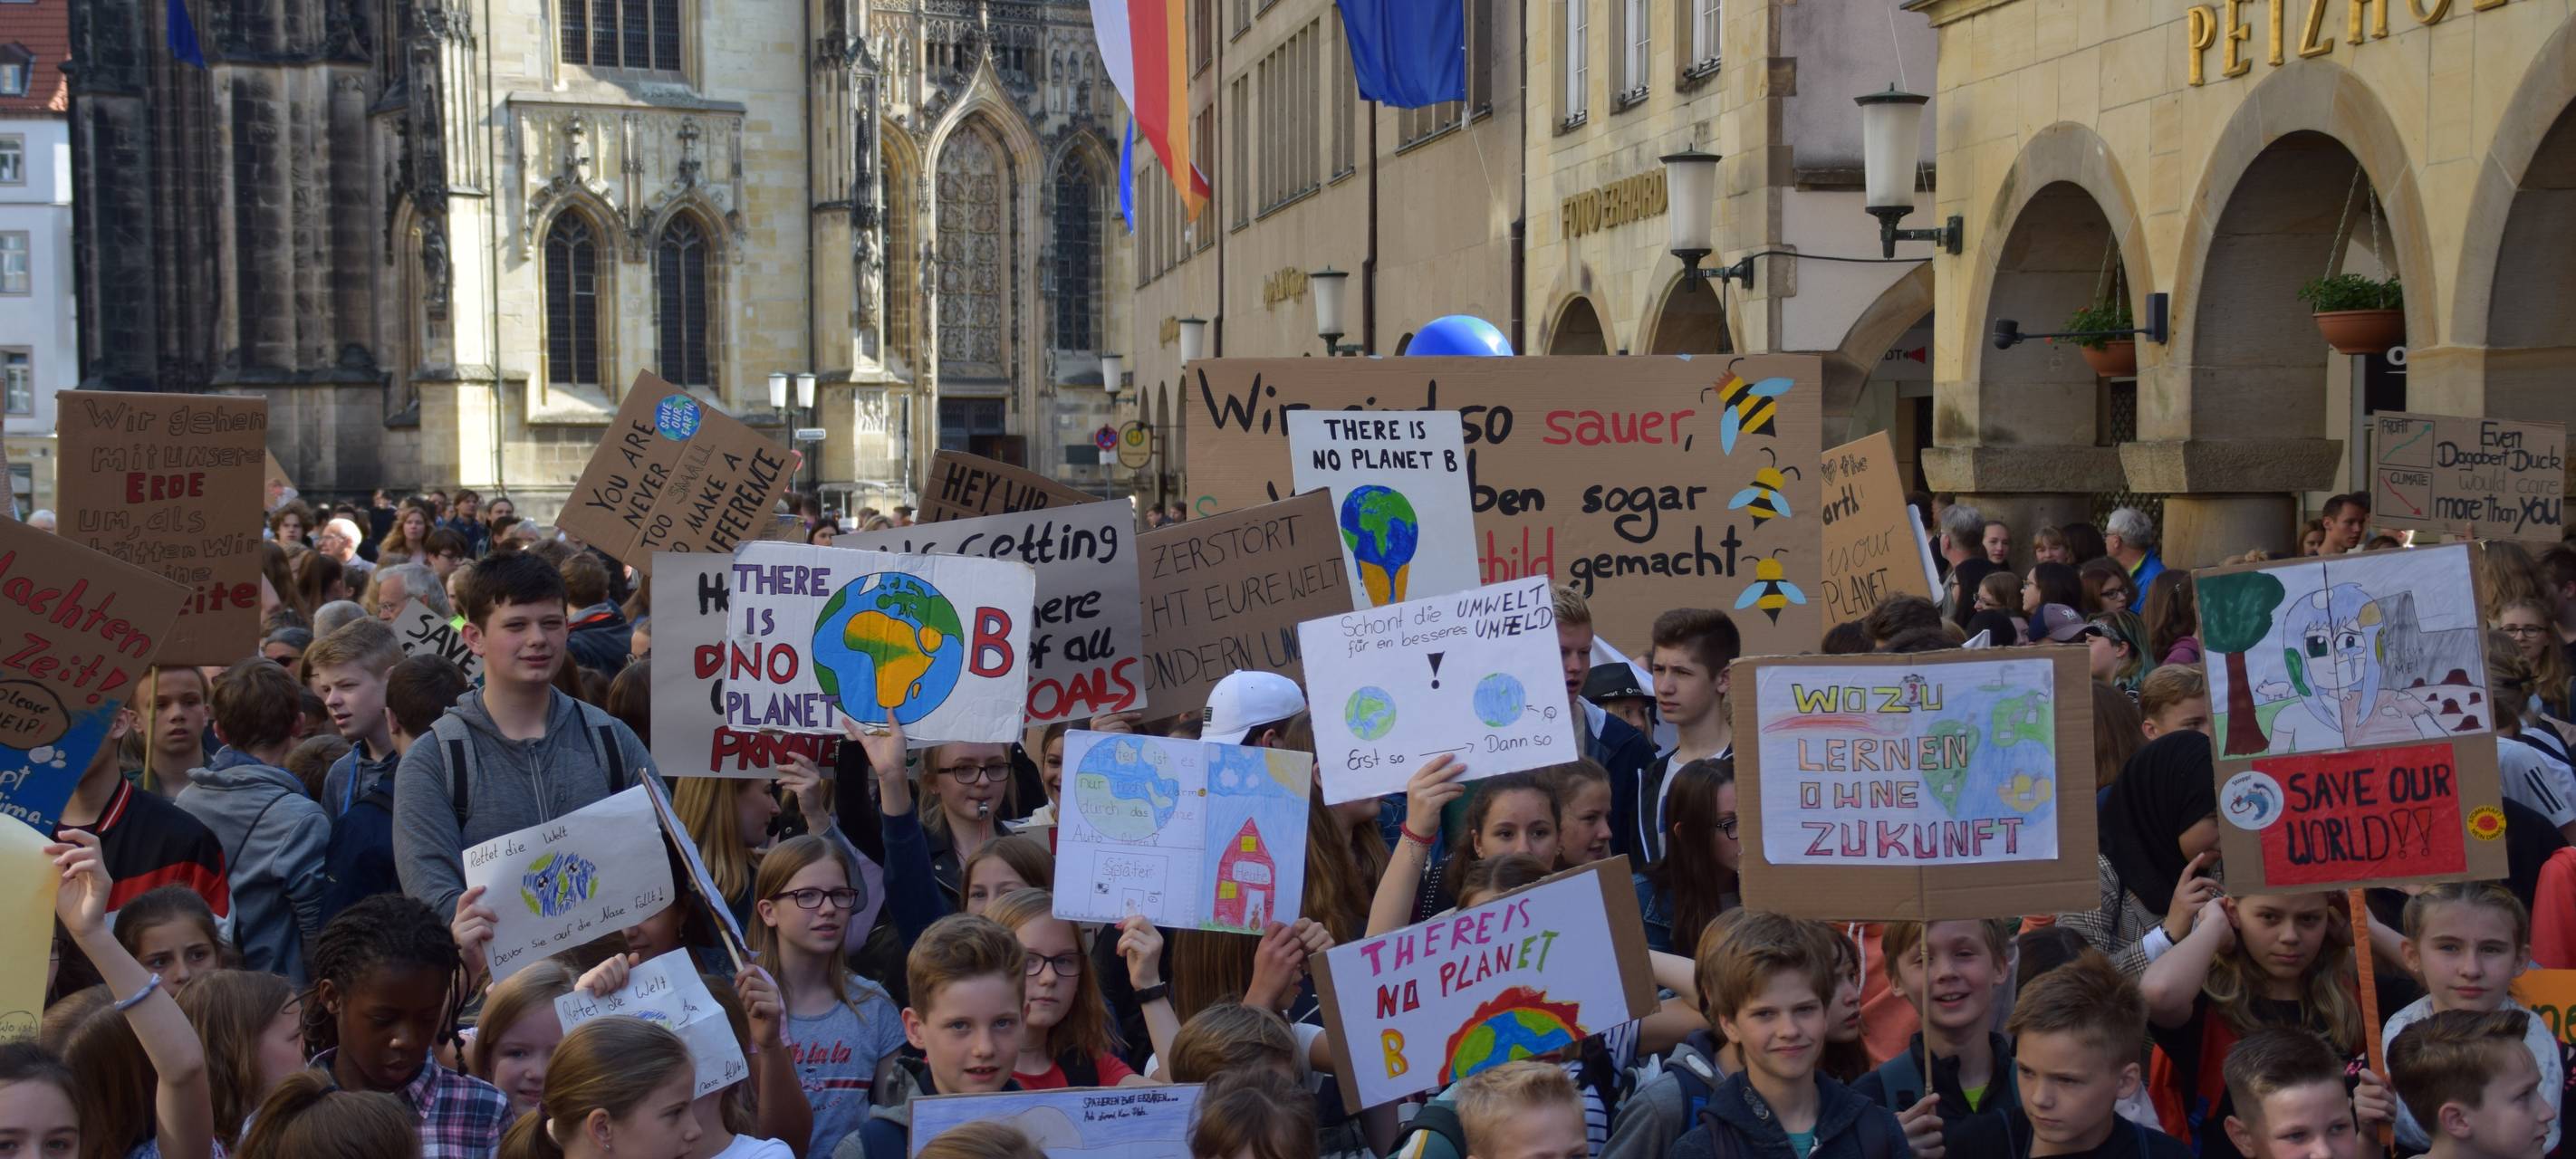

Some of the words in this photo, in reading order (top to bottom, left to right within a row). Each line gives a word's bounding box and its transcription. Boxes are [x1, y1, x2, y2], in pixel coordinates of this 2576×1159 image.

[1561, 188, 1601, 239] FOTO
[1601, 168, 1668, 229] ERHARD
[83, 398, 157, 432] Wir
[168, 406, 266, 436] gehen
[660, 402, 672, 428] SAVE
[671, 407, 683, 428] OUR
[681, 403, 695, 436] EARTH
[1197, 367, 1310, 436] Wir
[1461, 406, 1513, 445] so
[1543, 409, 1696, 452] sauer,
[619, 420, 656, 468] ARE
[1323, 418, 1401, 440] THERE
[1410, 421, 1426, 440] IS
[2481, 421, 2522, 448] Even
[91, 444, 159, 473] mit
[1313, 449, 1341, 471] NO
[1351, 449, 1433, 470] PLANET
[1445, 449, 1457, 473] B
[2437, 441, 2509, 472] Dagobert
[2510, 445, 2562, 472] Duck
[126, 473, 206, 503] ERDE
[623, 463, 670, 530] NEVER
[640, 513, 673, 548] TOO
[668, 445, 716, 505] SMALL
[684, 474, 726, 534] MAKE
[724, 454, 743, 472] A
[941, 463, 1000, 512] HEY
[1468, 449, 1544, 515] ben
[1581, 484, 1707, 544] sogar
[2389, 471, 2428, 486] CLIMATE
[2458, 469, 2505, 493] would
[2515, 477, 2560, 495] care
[705, 447, 785, 554] IFFERENCE
[1822, 484, 1864, 525] arth!
[2436, 496, 2483, 521] more
[147, 506, 206, 533] als
[1151, 514, 1304, 580] ZERSTÖRT
[1570, 524, 1743, 599] gemacht
[733, 564, 831, 597] THERE
[1205, 573, 1284, 622] EURE
[1288, 558, 1343, 601] WELT
[745, 608, 774, 636] IS
[1341, 608, 1404, 637] Schont
[1414, 606, 1443, 626] die
[1456, 584, 1545, 618] UMWELT
[406, 615, 476, 676] SAVE
[730, 640, 799, 685] NO
[969, 607, 1014, 677] B
[1063, 627, 1116, 662] all
[1349, 639, 1367, 658] für
[1401, 625, 1467, 647] besseres
[1475, 607, 1552, 640] UMFELD
[2, 632, 129, 704] Zeit!
[1024, 656, 1138, 723] OALS
[1792, 683, 1942, 714] WOZU
[726, 692, 841, 727] PLANET
[1152, 751, 1168, 765] ist
[1180, 757, 1195, 767] es
[1347, 749, 1381, 771] Erst
[1389, 754, 1405, 764] so
[1485, 734, 1528, 752] Dann
[1533, 734, 1552, 746] so
[1798, 735, 1968, 771] LERNEN
[1800, 780, 1919, 809] OHNE
[2288, 768, 2376, 812] SAVE
[2389, 764, 2450, 802] OUR
[1080, 799, 1120, 816] durch
[1130, 806, 1149, 818] das
[470, 846, 499, 867] Rettet
[505, 839, 526, 857] die
[542, 826, 568, 844] Welt
[1072, 824, 1102, 843] Auto
[1802, 818, 2023, 858] ZUKUNFT
[1102, 857, 1154, 883] Später
[492, 946, 524, 966] bevor
[532, 939, 547, 948] sie
[553, 924, 572, 941] auf
[578, 920, 591, 931] die
[600, 905, 626, 924] Nase
[1360, 912, 1495, 977] THERE
[1501, 897, 1531, 934] IS
[635, 976, 667, 999] Welt
[1377, 979, 1420, 1020] NO
[1439, 930, 1560, 997] PLANET
[1381, 1028, 1409, 1079] B
